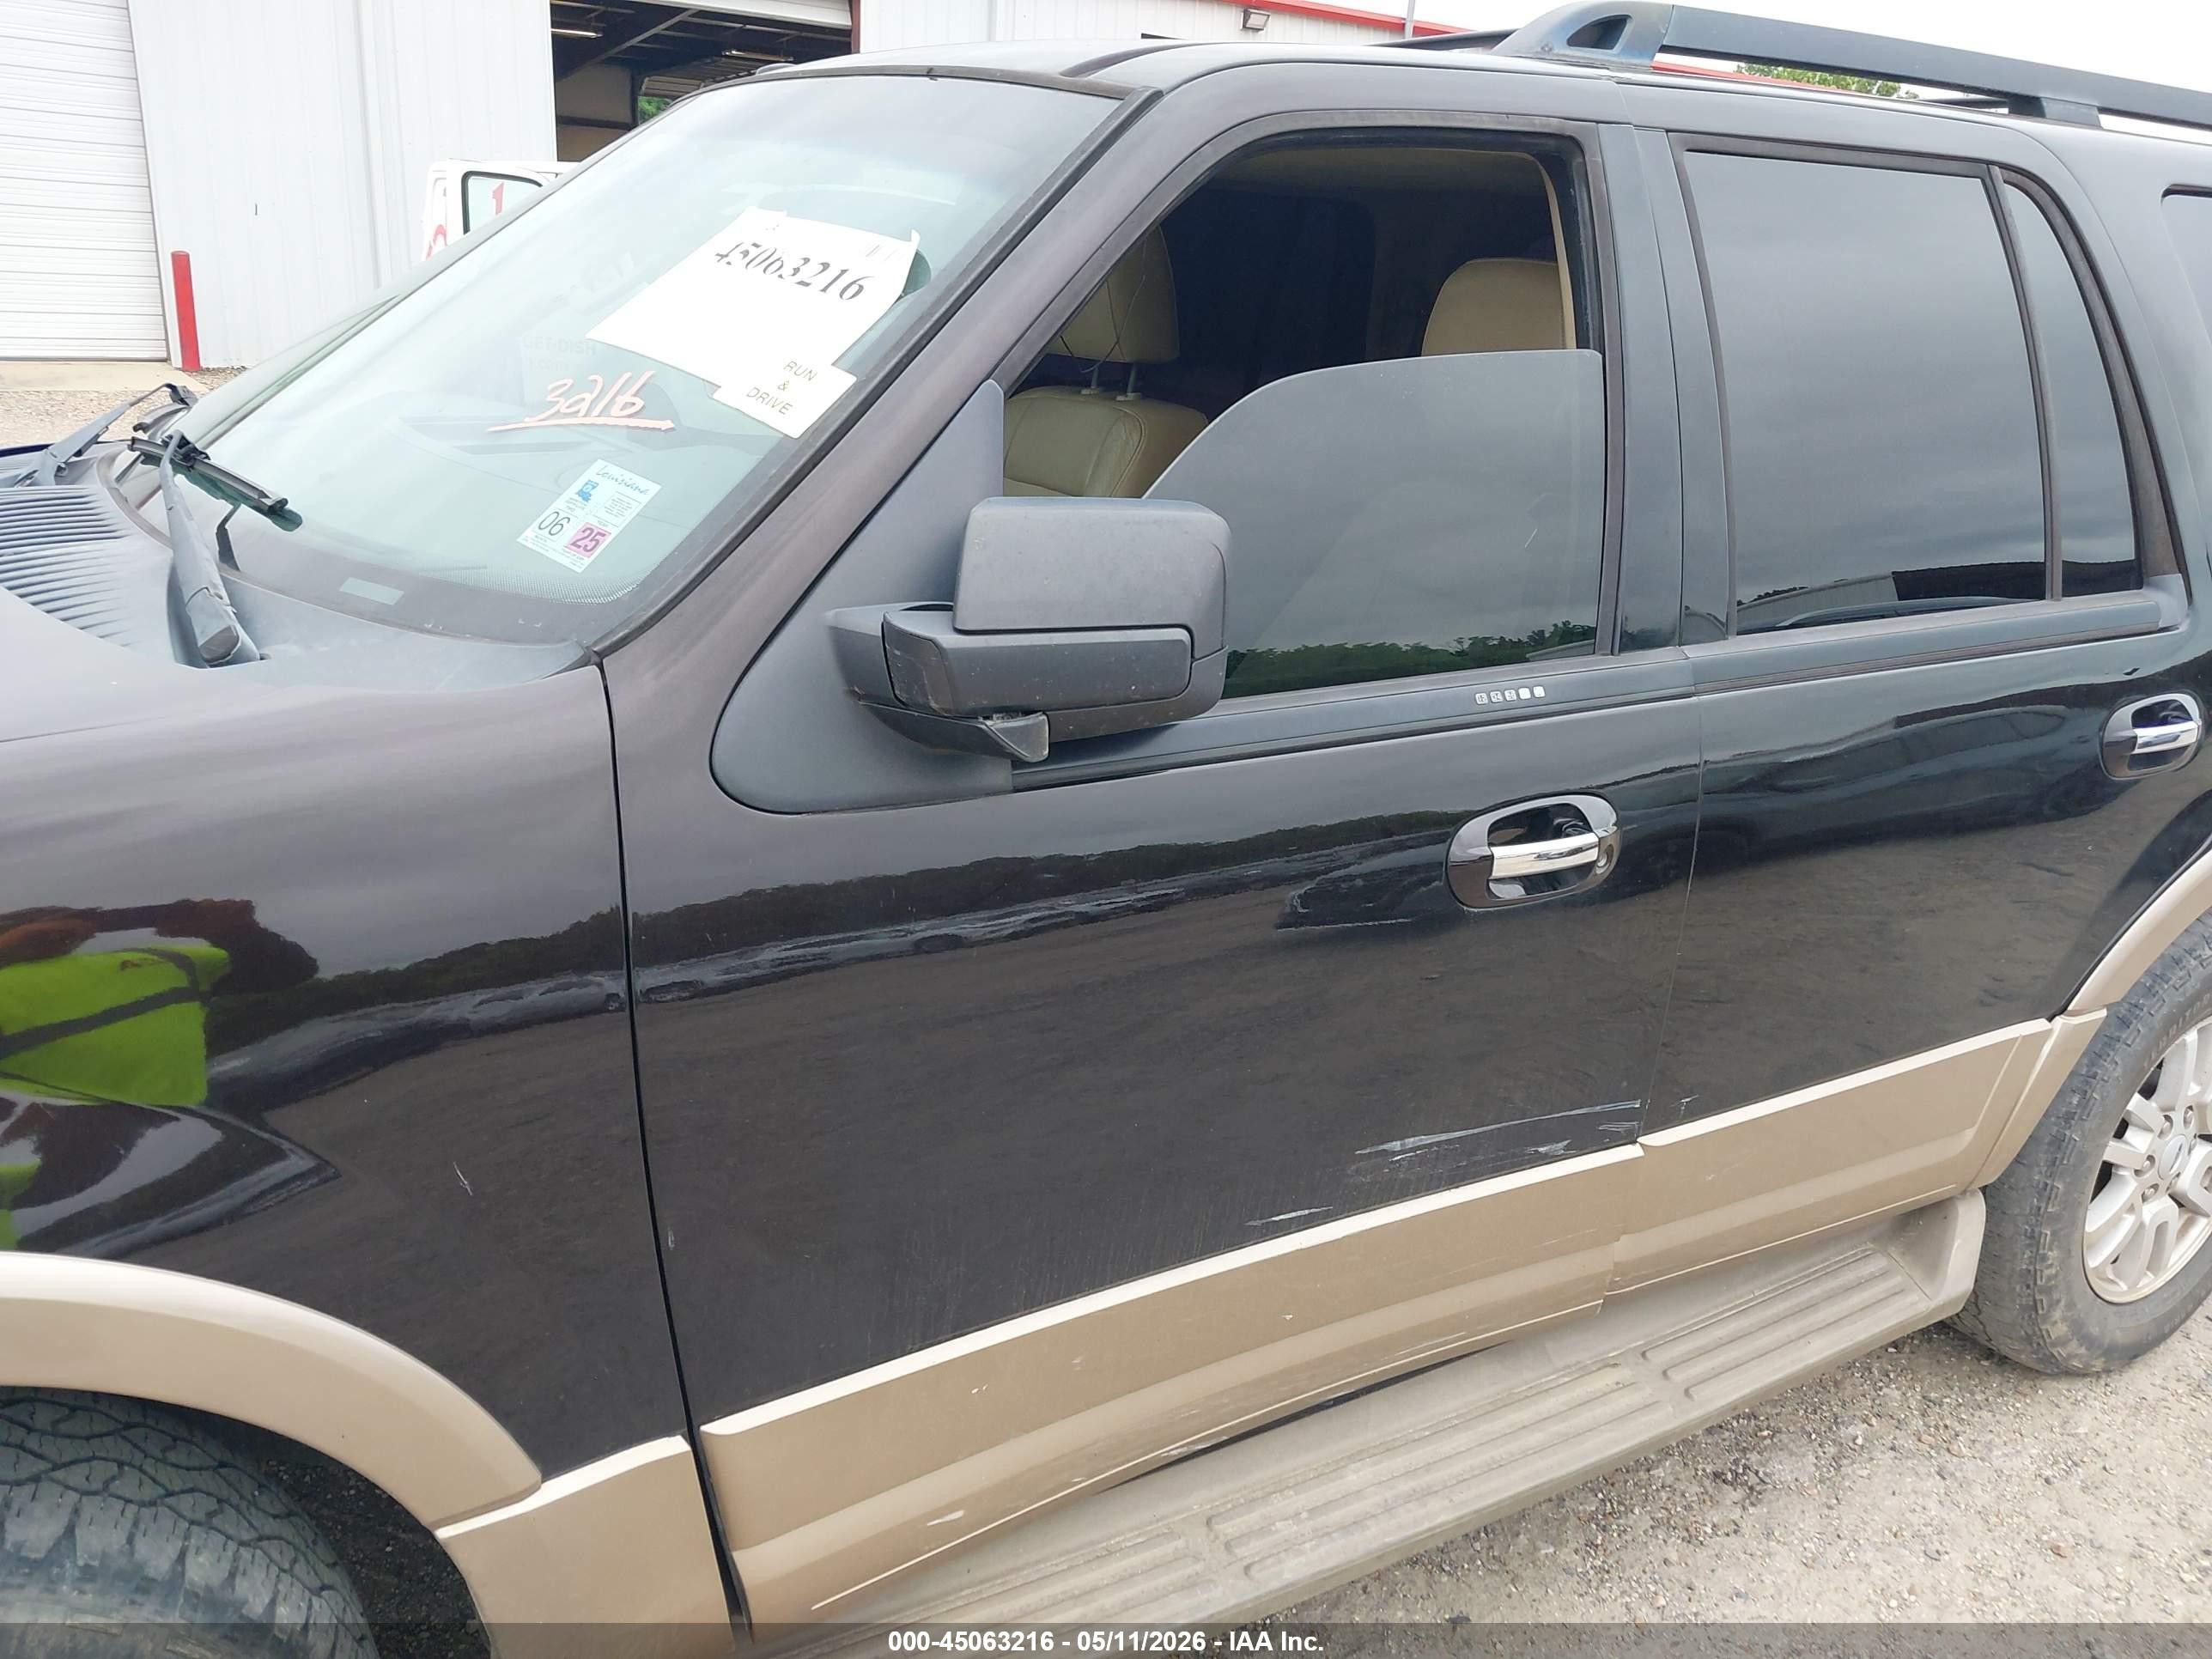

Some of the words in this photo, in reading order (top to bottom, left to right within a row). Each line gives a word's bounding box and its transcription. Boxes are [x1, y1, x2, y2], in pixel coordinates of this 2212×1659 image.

[714, 241, 875, 301] 45063216
[783, 360, 817, 382] RUN
[523, 370, 656, 422] 3216
[777, 379, 791, 392] &
[745, 386, 794, 416] DRIVE
[538, 511, 571, 537] 06
[569, 526, 607, 553] 25
